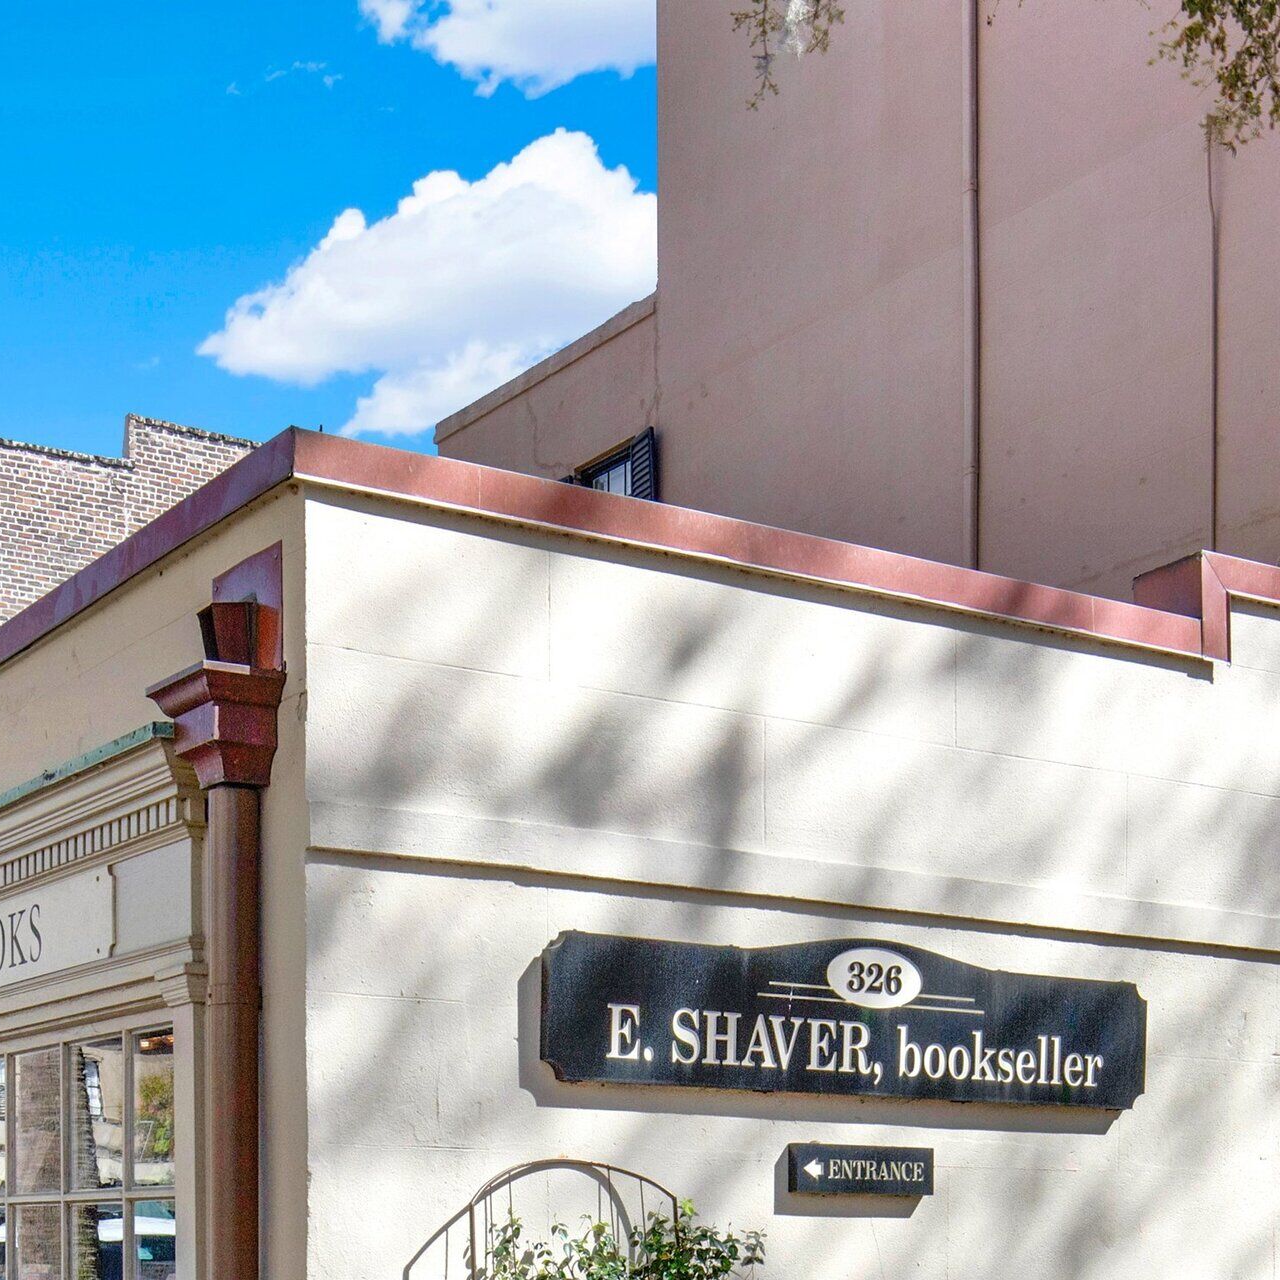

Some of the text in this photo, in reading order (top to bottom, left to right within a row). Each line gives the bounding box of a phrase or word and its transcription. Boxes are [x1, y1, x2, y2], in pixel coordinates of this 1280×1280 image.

[846, 961, 903, 996] 326
[605, 1002, 1104, 1087] E. SHAVER, bookseller
[827, 1158, 925, 1183] ENTRANCE
